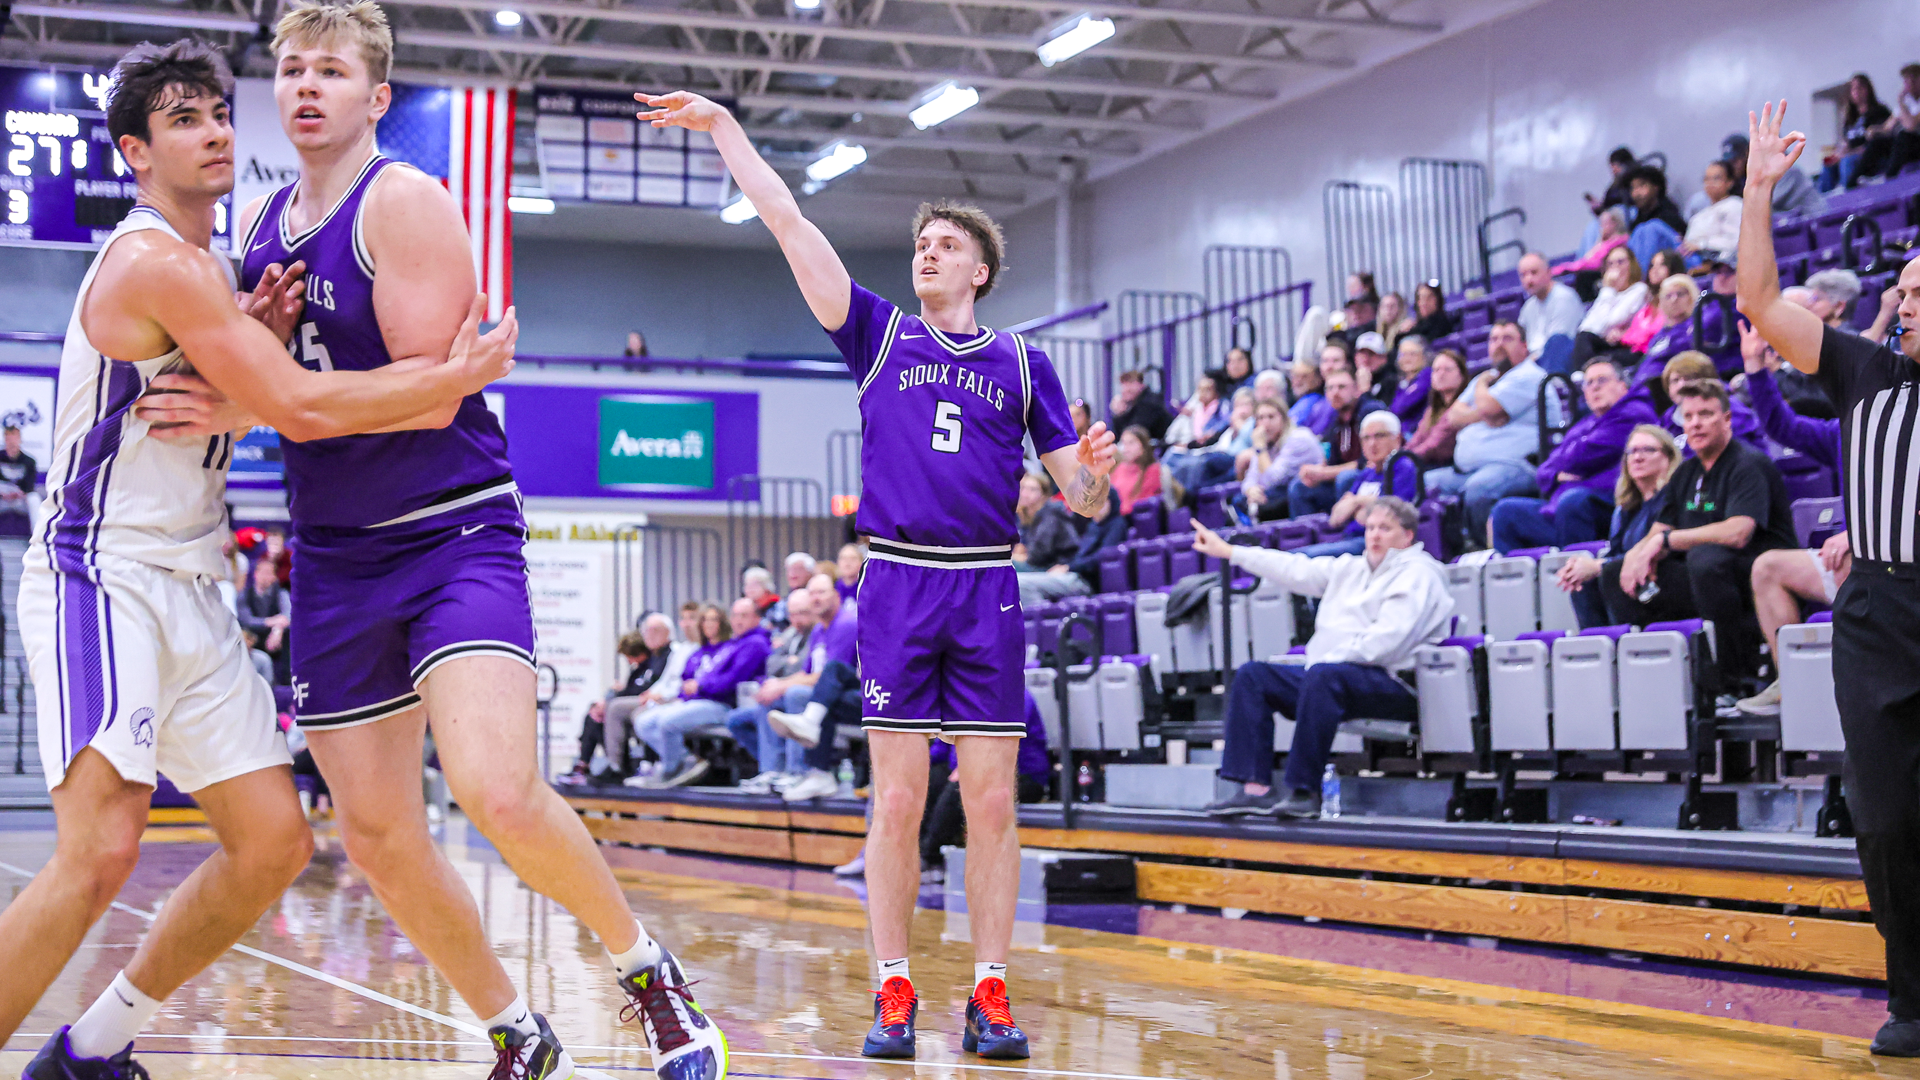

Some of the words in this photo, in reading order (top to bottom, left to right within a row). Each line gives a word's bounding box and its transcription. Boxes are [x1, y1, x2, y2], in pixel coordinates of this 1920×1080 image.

[9, 134, 61, 176] 27
[241, 154, 300, 183] Ave
[9, 189, 29, 224] 3
[305, 273, 336, 311] LLS
[287, 321, 335, 372] 5
[898, 363, 951, 392] SIOUX
[956, 366, 1005, 412] FALLS
[610, 428, 681, 458] Avera
[930, 399, 963, 454] 5
[864, 679, 892, 711] USF
